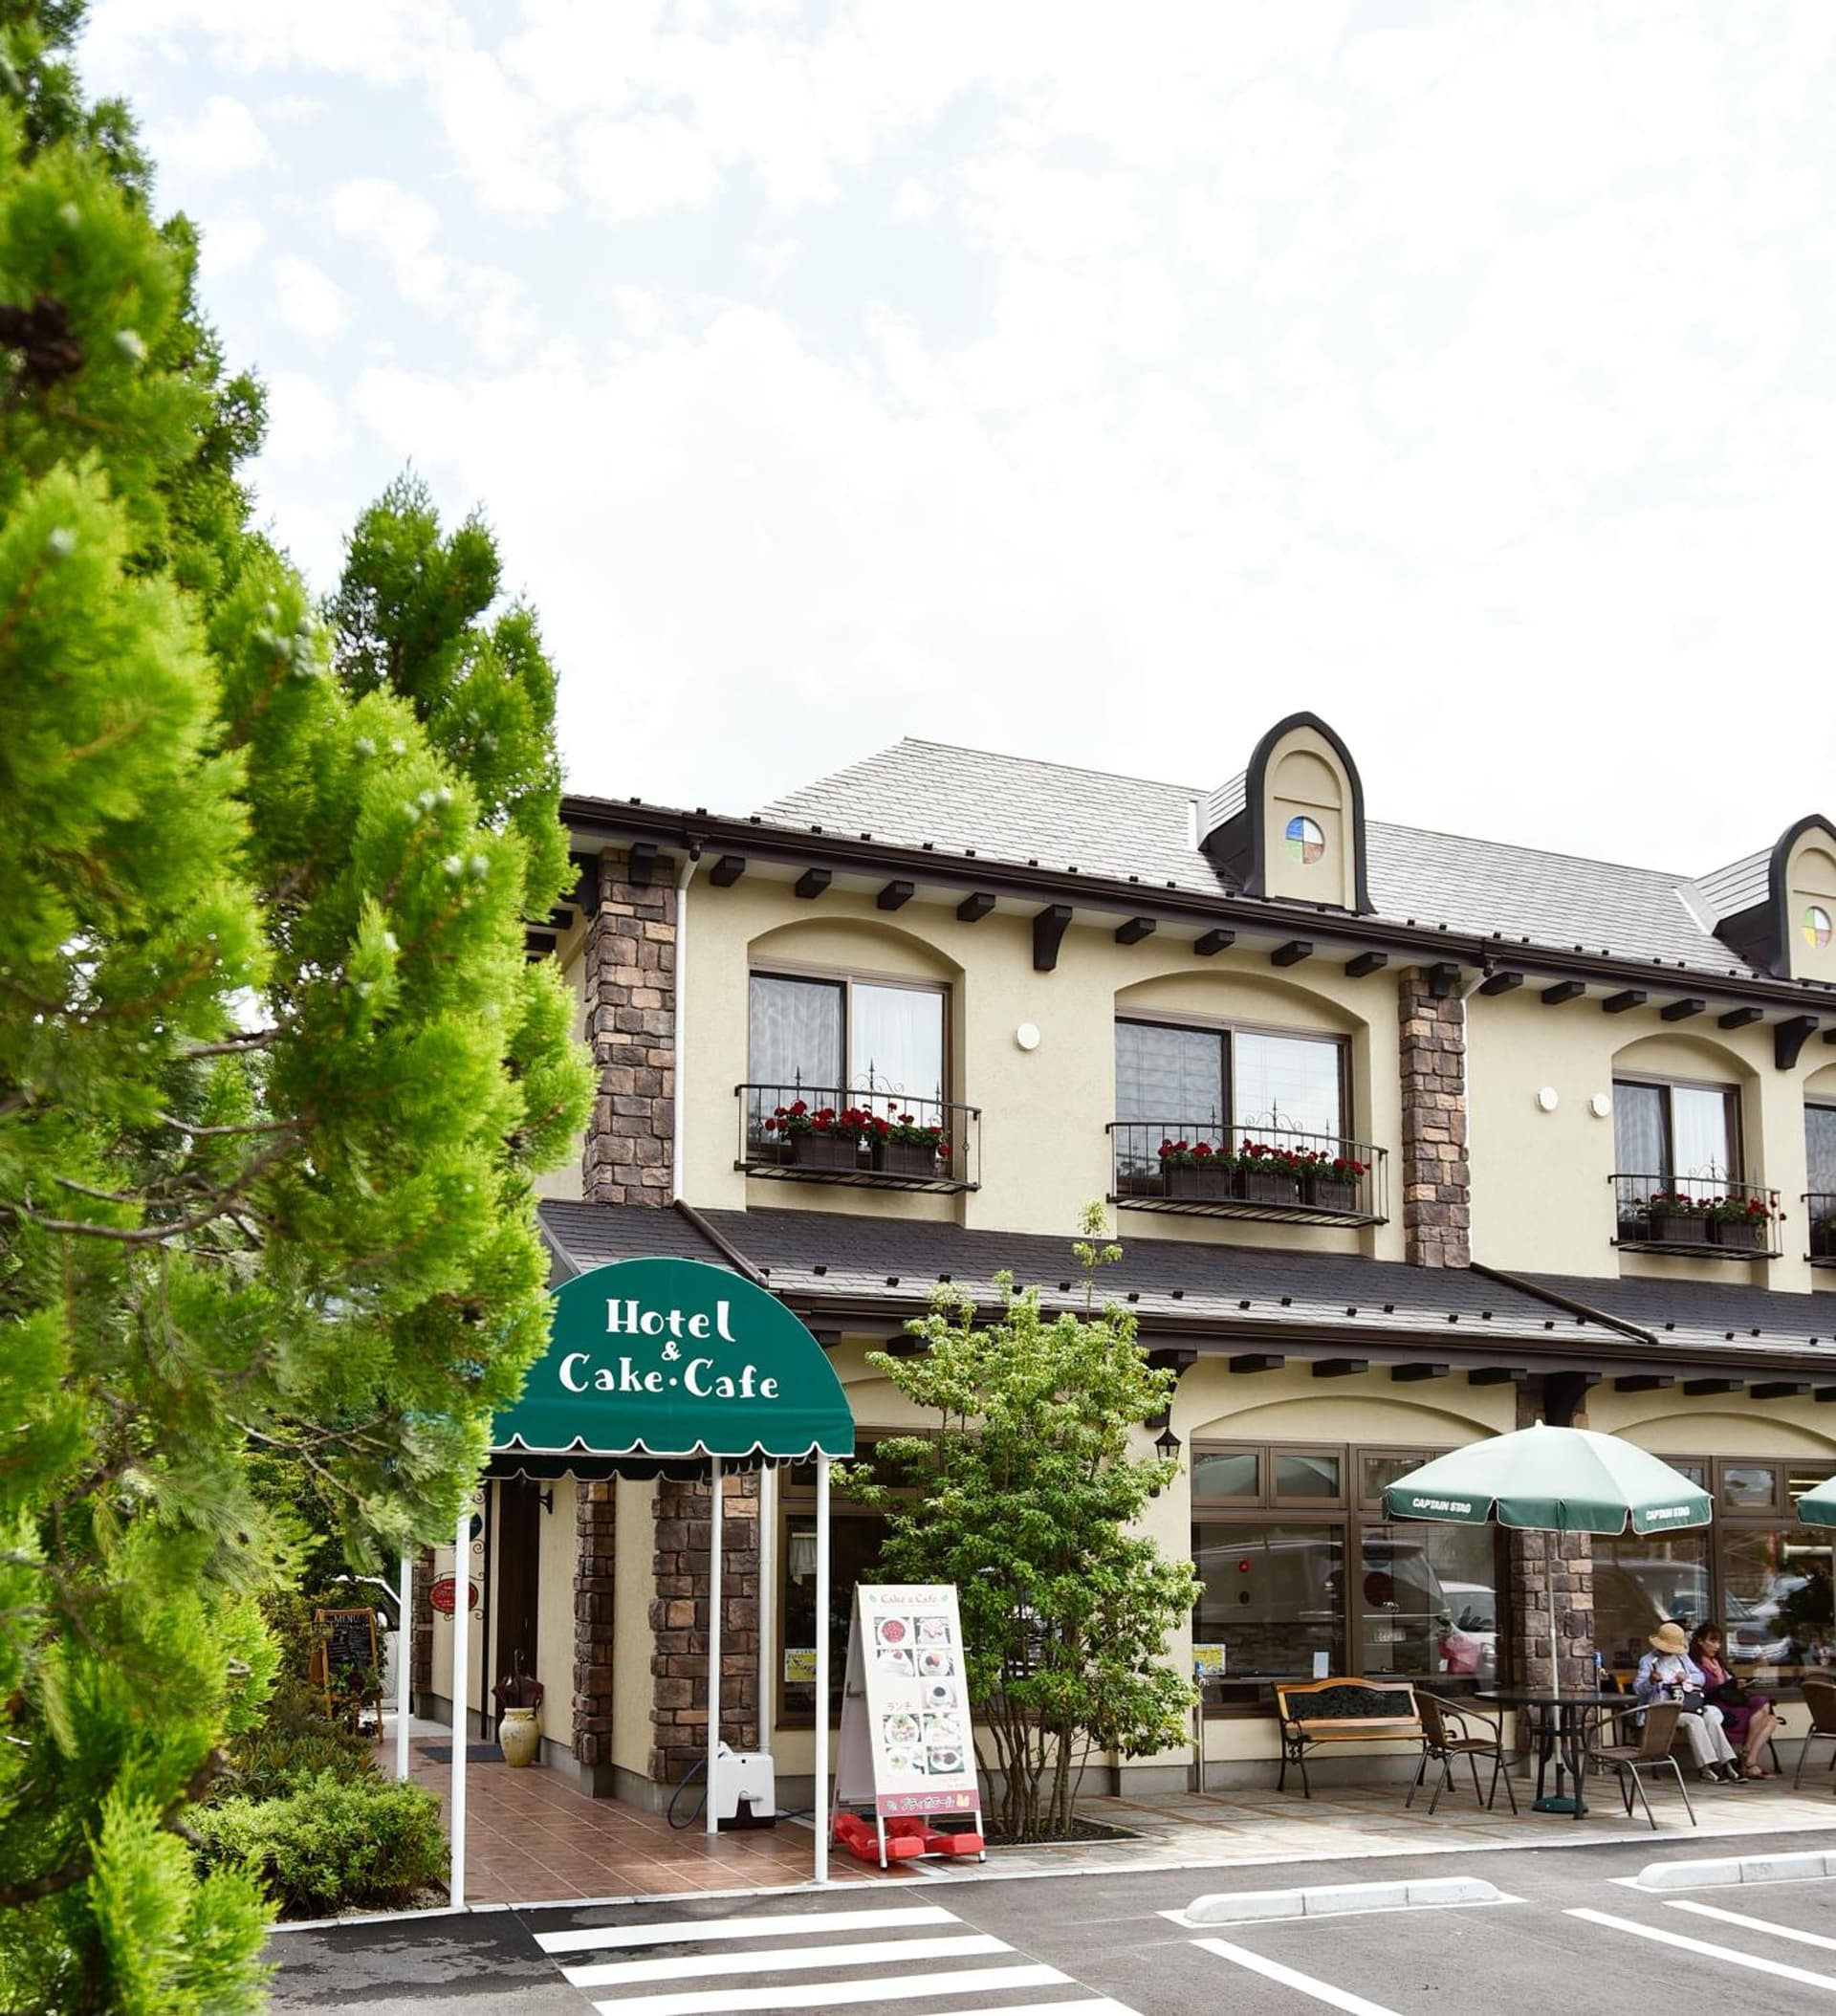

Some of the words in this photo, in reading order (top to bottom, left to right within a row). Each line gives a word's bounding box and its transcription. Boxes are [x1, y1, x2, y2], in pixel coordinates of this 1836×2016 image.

[605, 1298, 736, 1342] Hotel
[661, 1341, 682, 1362] &
[1412, 1498, 1450, 1512] CAPTAIN
